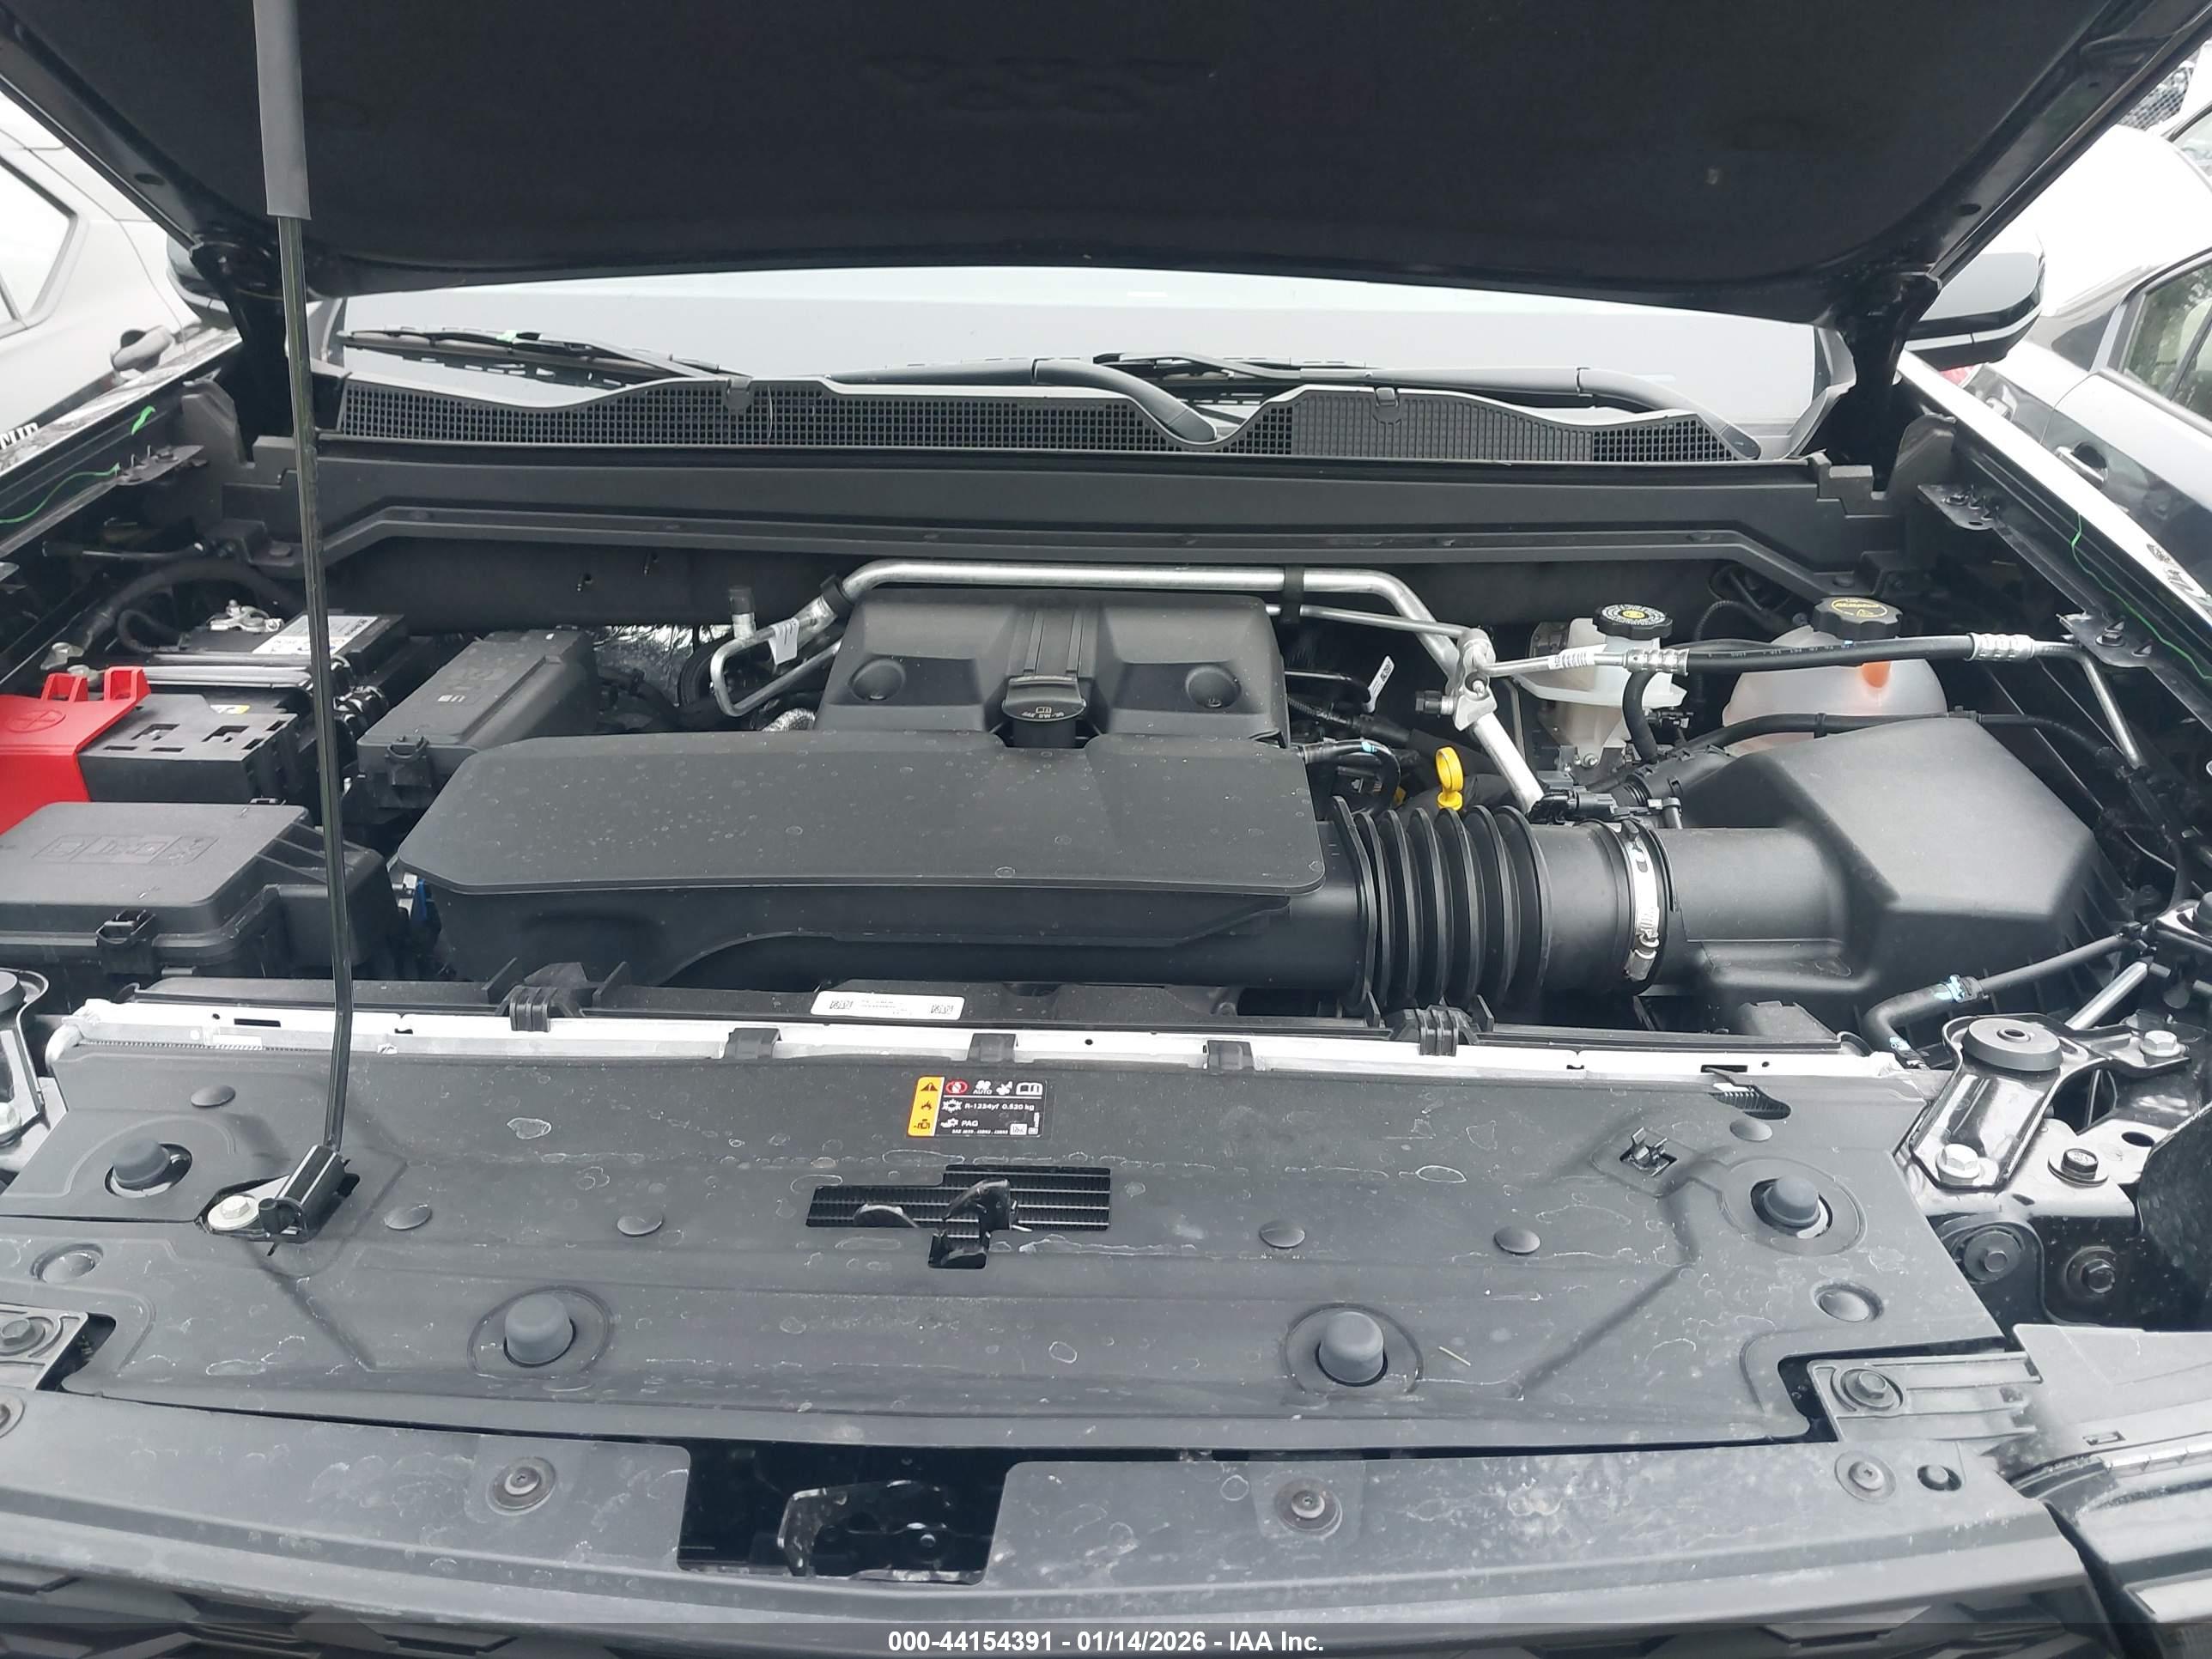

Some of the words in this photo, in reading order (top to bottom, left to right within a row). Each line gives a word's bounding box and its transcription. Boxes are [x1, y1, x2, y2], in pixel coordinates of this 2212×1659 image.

[964, 1103, 1000, 1111] R-1234yf
[1024, 1103, 1035, 1112] kg
[961, 1119, 979, 1127] PAG
